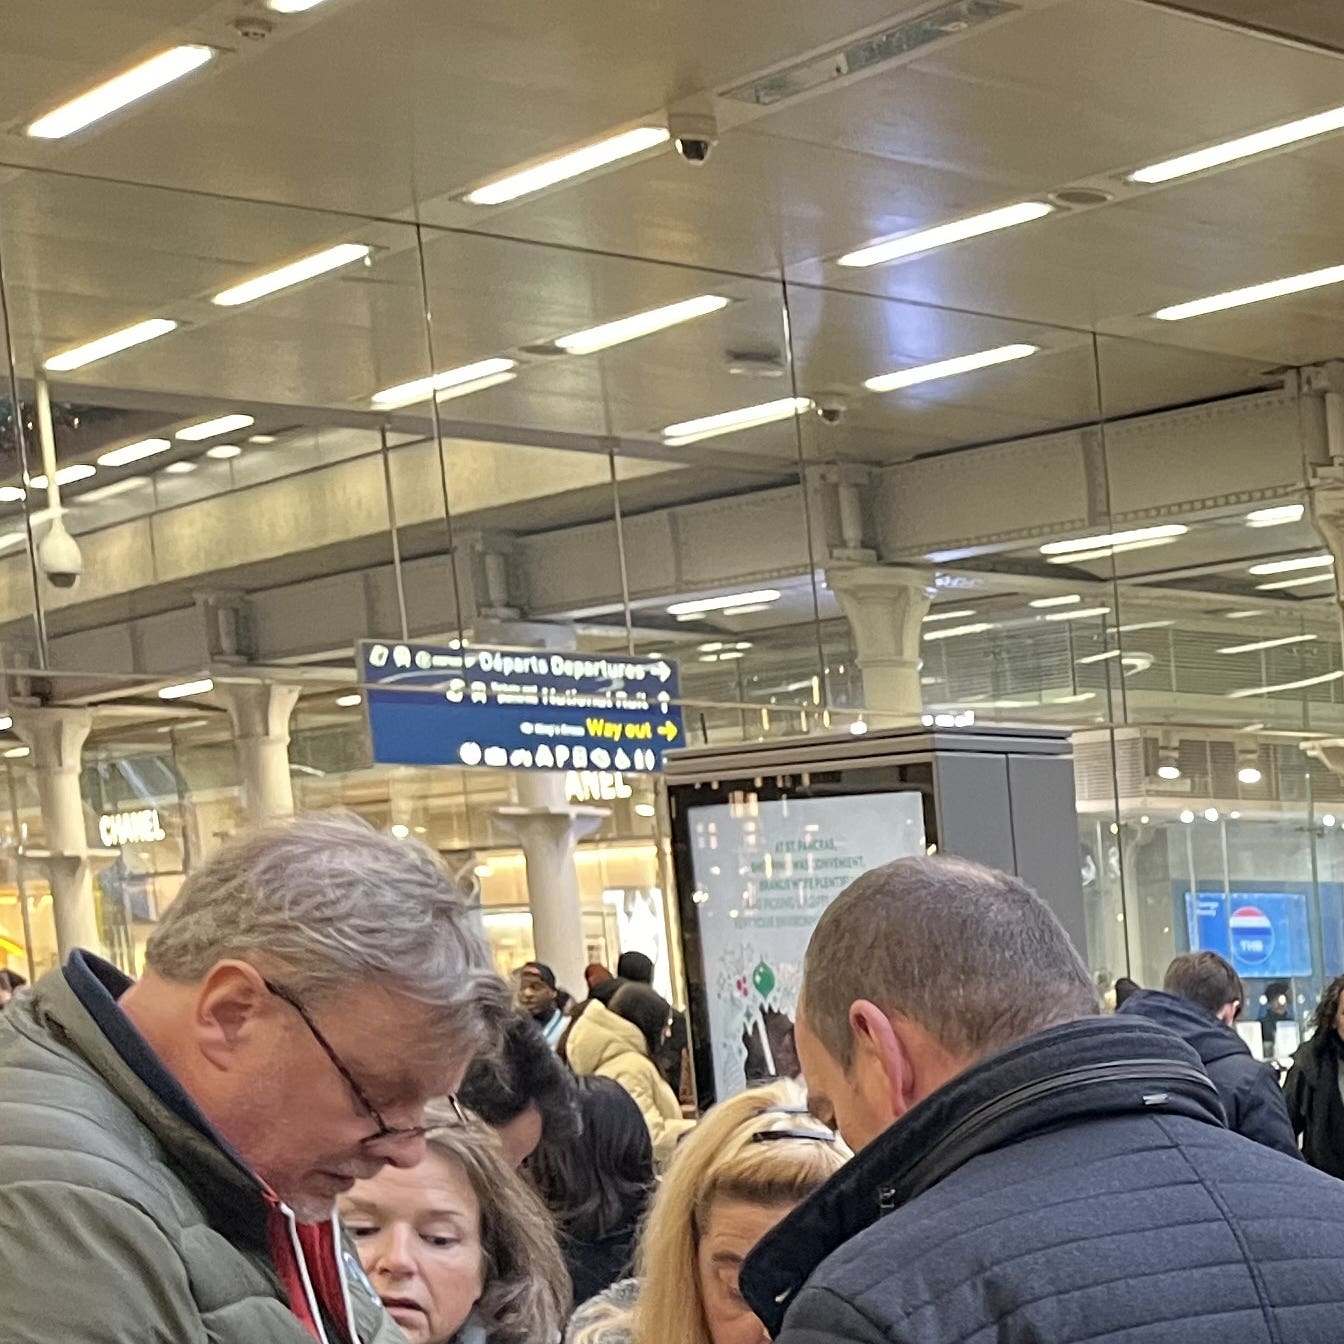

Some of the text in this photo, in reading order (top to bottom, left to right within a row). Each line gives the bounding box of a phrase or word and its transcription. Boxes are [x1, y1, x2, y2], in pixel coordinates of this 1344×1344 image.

[478, 651, 549, 677] Départs
[551, 654, 646, 681] Departures
[586, 717, 622, 741] Way
[624, 721, 653, 740] out
[99, 808, 166, 847] CHANEL
